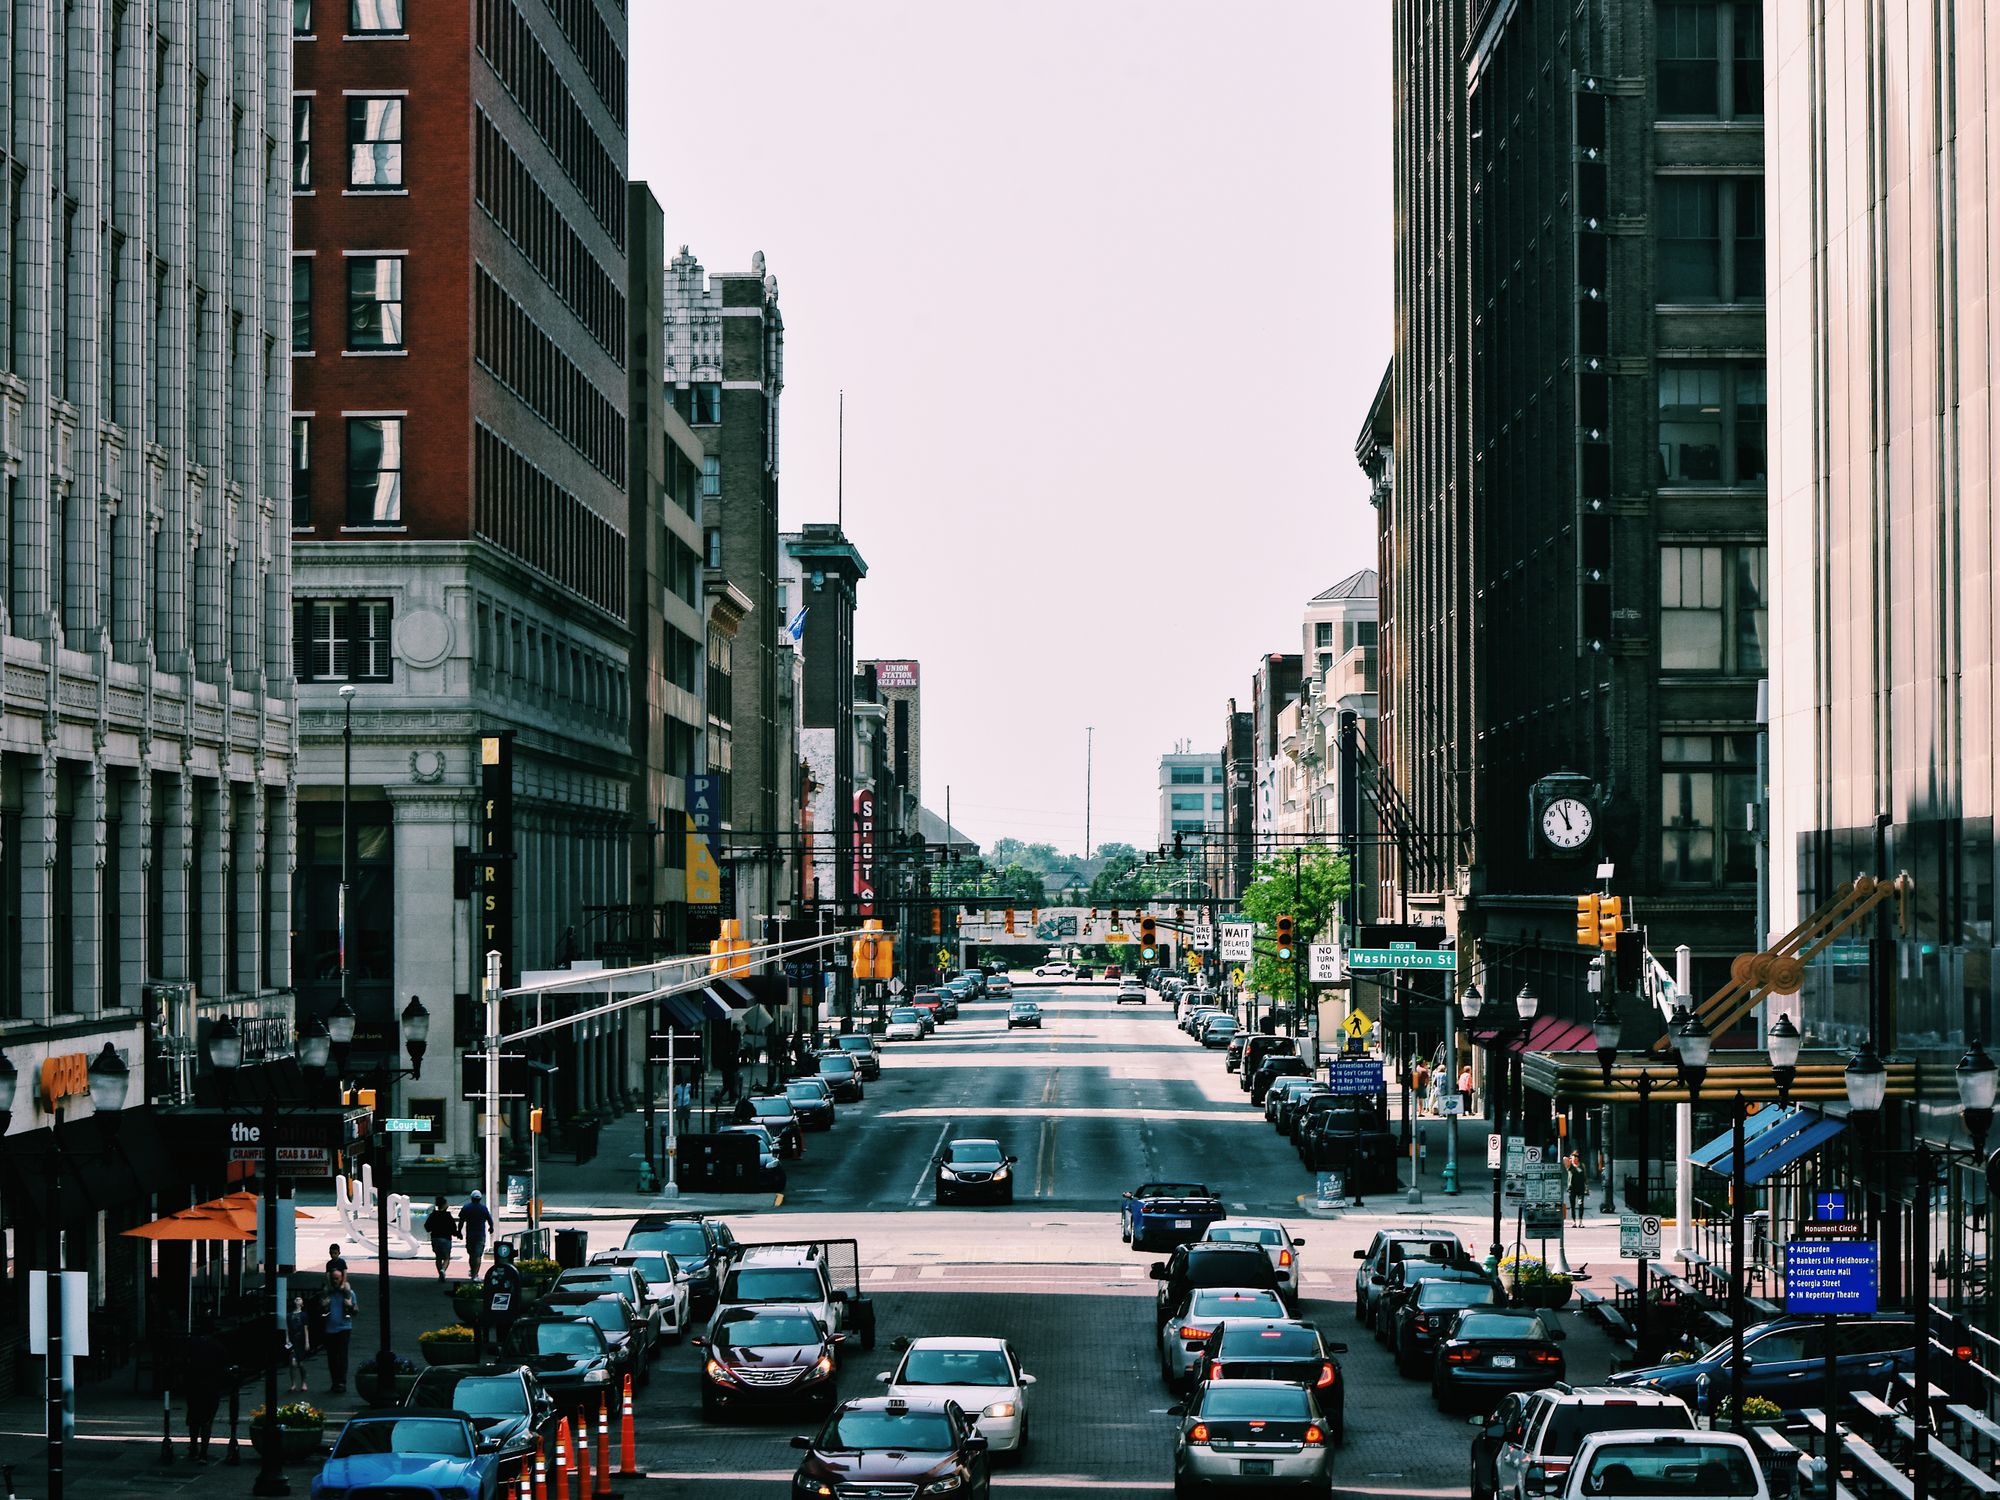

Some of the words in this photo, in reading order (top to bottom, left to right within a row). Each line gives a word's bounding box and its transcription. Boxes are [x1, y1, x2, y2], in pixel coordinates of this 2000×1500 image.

[1225, 928, 1249, 938] WAIT
[1224, 940, 1250, 948] DELAYED
[1319, 947, 1332, 955] NO
[1354, 953, 1432, 966] Washington
[1438, 955, 1452, 965] St
[393, 1120, 418, 1130] Court
[231, 1121, 261, 1142] the
[278, 1149, 298, 1159] CRAB
[308, 1149, 324, 1159] BAR
[1797, 1246, 1830, 1254] Artsgarden
[1797, 1280, 1820, 1288] Georgia
